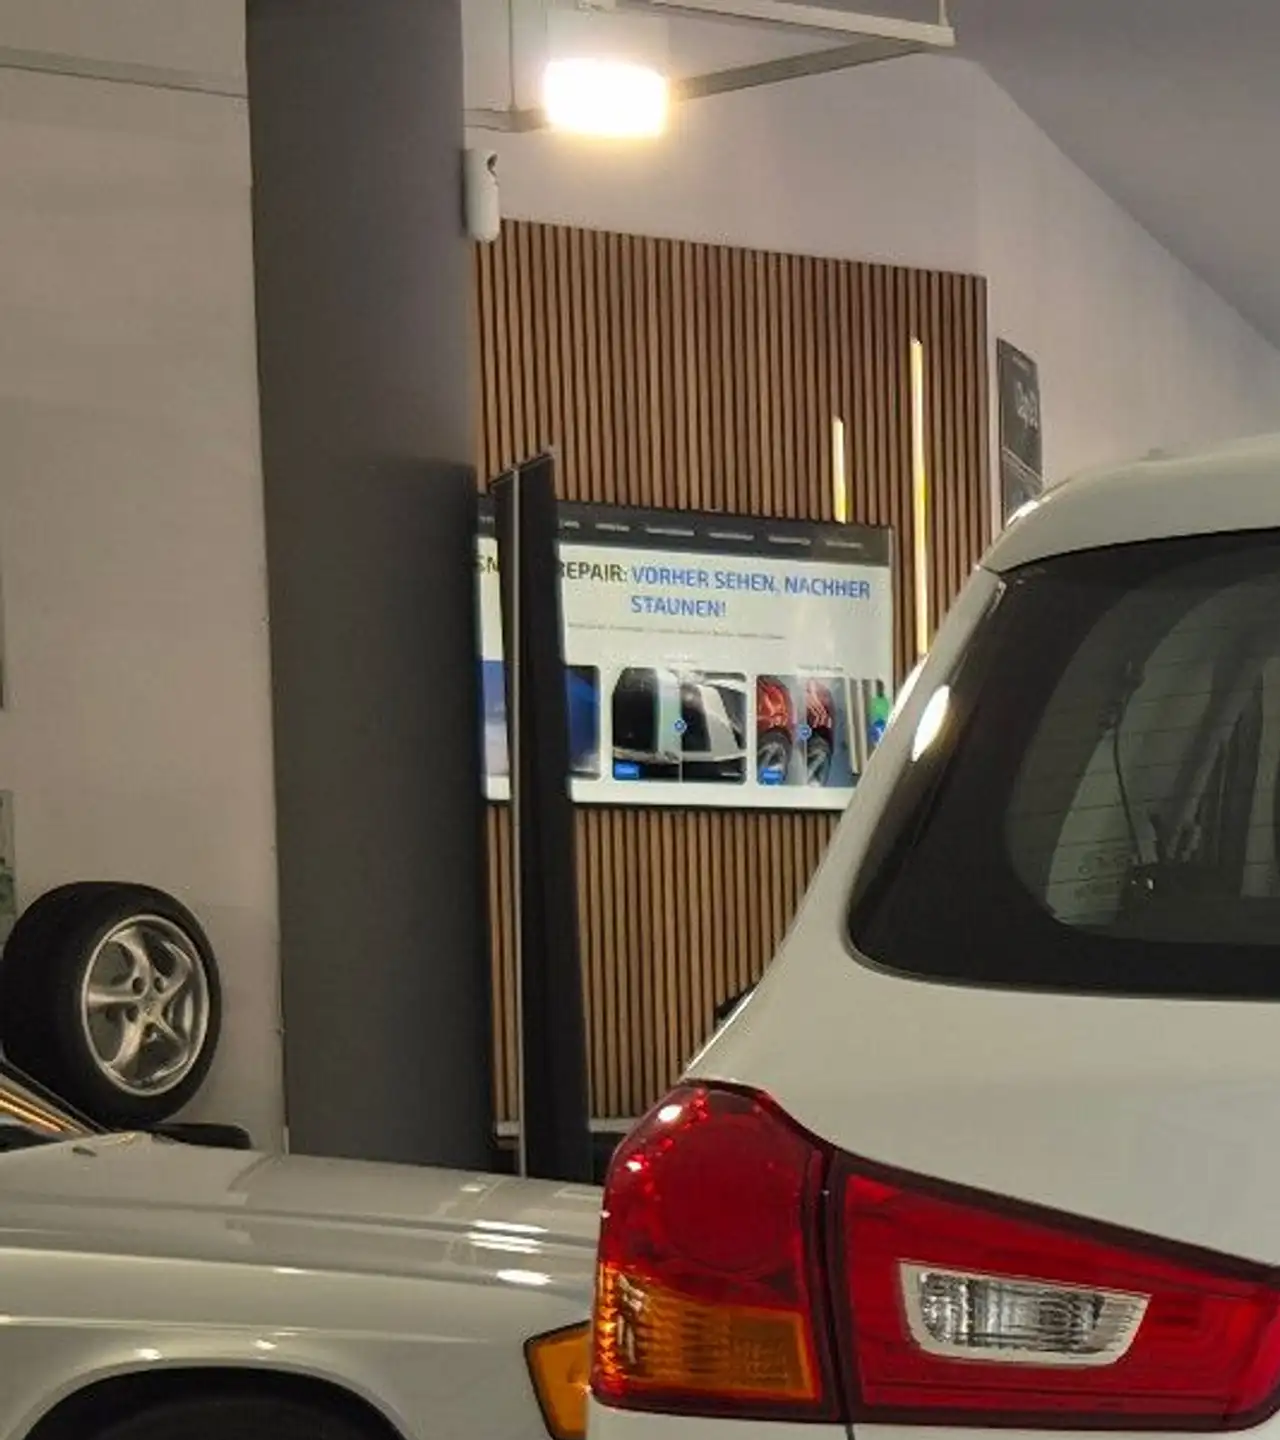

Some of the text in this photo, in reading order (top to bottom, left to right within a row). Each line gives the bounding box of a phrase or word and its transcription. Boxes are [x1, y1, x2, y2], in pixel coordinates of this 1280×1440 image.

[632, 566, 709, 589] VORHER
[784, 575, 870, 600] NACHHER
[631, 596, 726, 617] STAUNEN!
